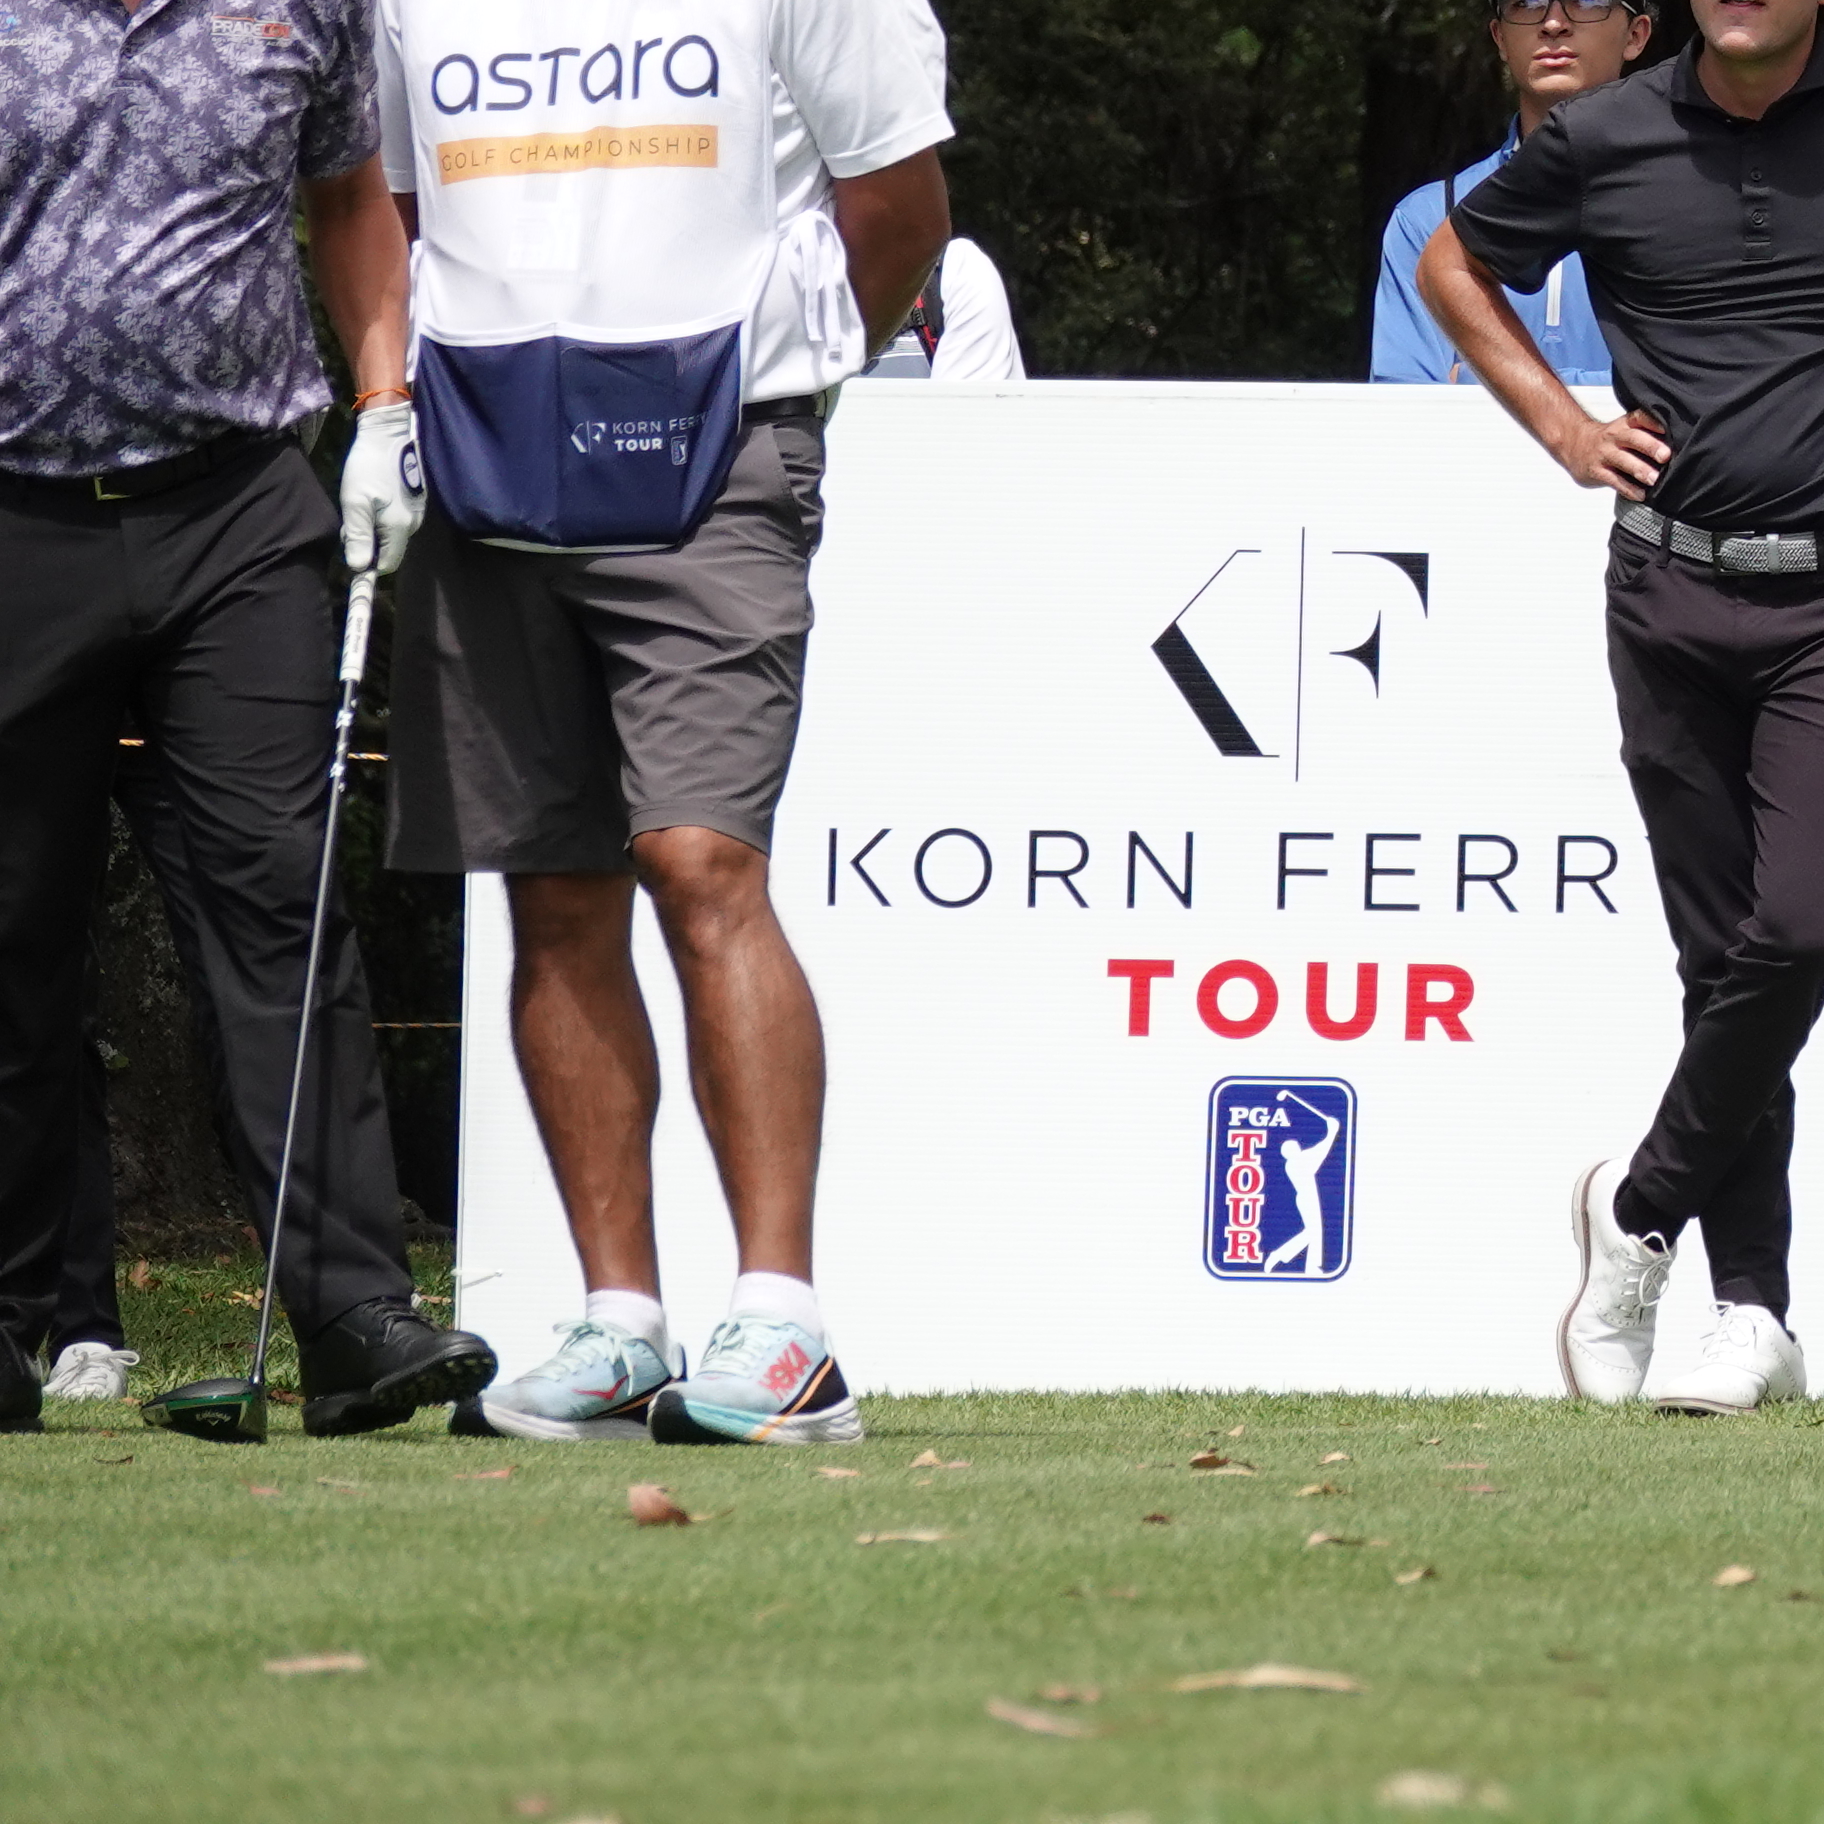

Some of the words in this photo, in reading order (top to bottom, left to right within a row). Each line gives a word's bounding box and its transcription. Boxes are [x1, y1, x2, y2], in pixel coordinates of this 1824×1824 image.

[430, 34, 720, 116] astara
[441, 148, 497, 173] GOLF
[509, 136, 712, 165] CHAMPIONSHIP
[612, 420, 662, 435] KORN
[614, 437, 664, 452] TOUR
[826, 827, 1195, 910] KORN
[1276, 831, 1650, 914] FERR
[1107, 958, 1476, 1043] TOUR
[1228, 1107, 1291, 1127] PGA
[1223, 1129, 1268, 1264] TOUR
[757, 1340, 813, 1404] HOKA
